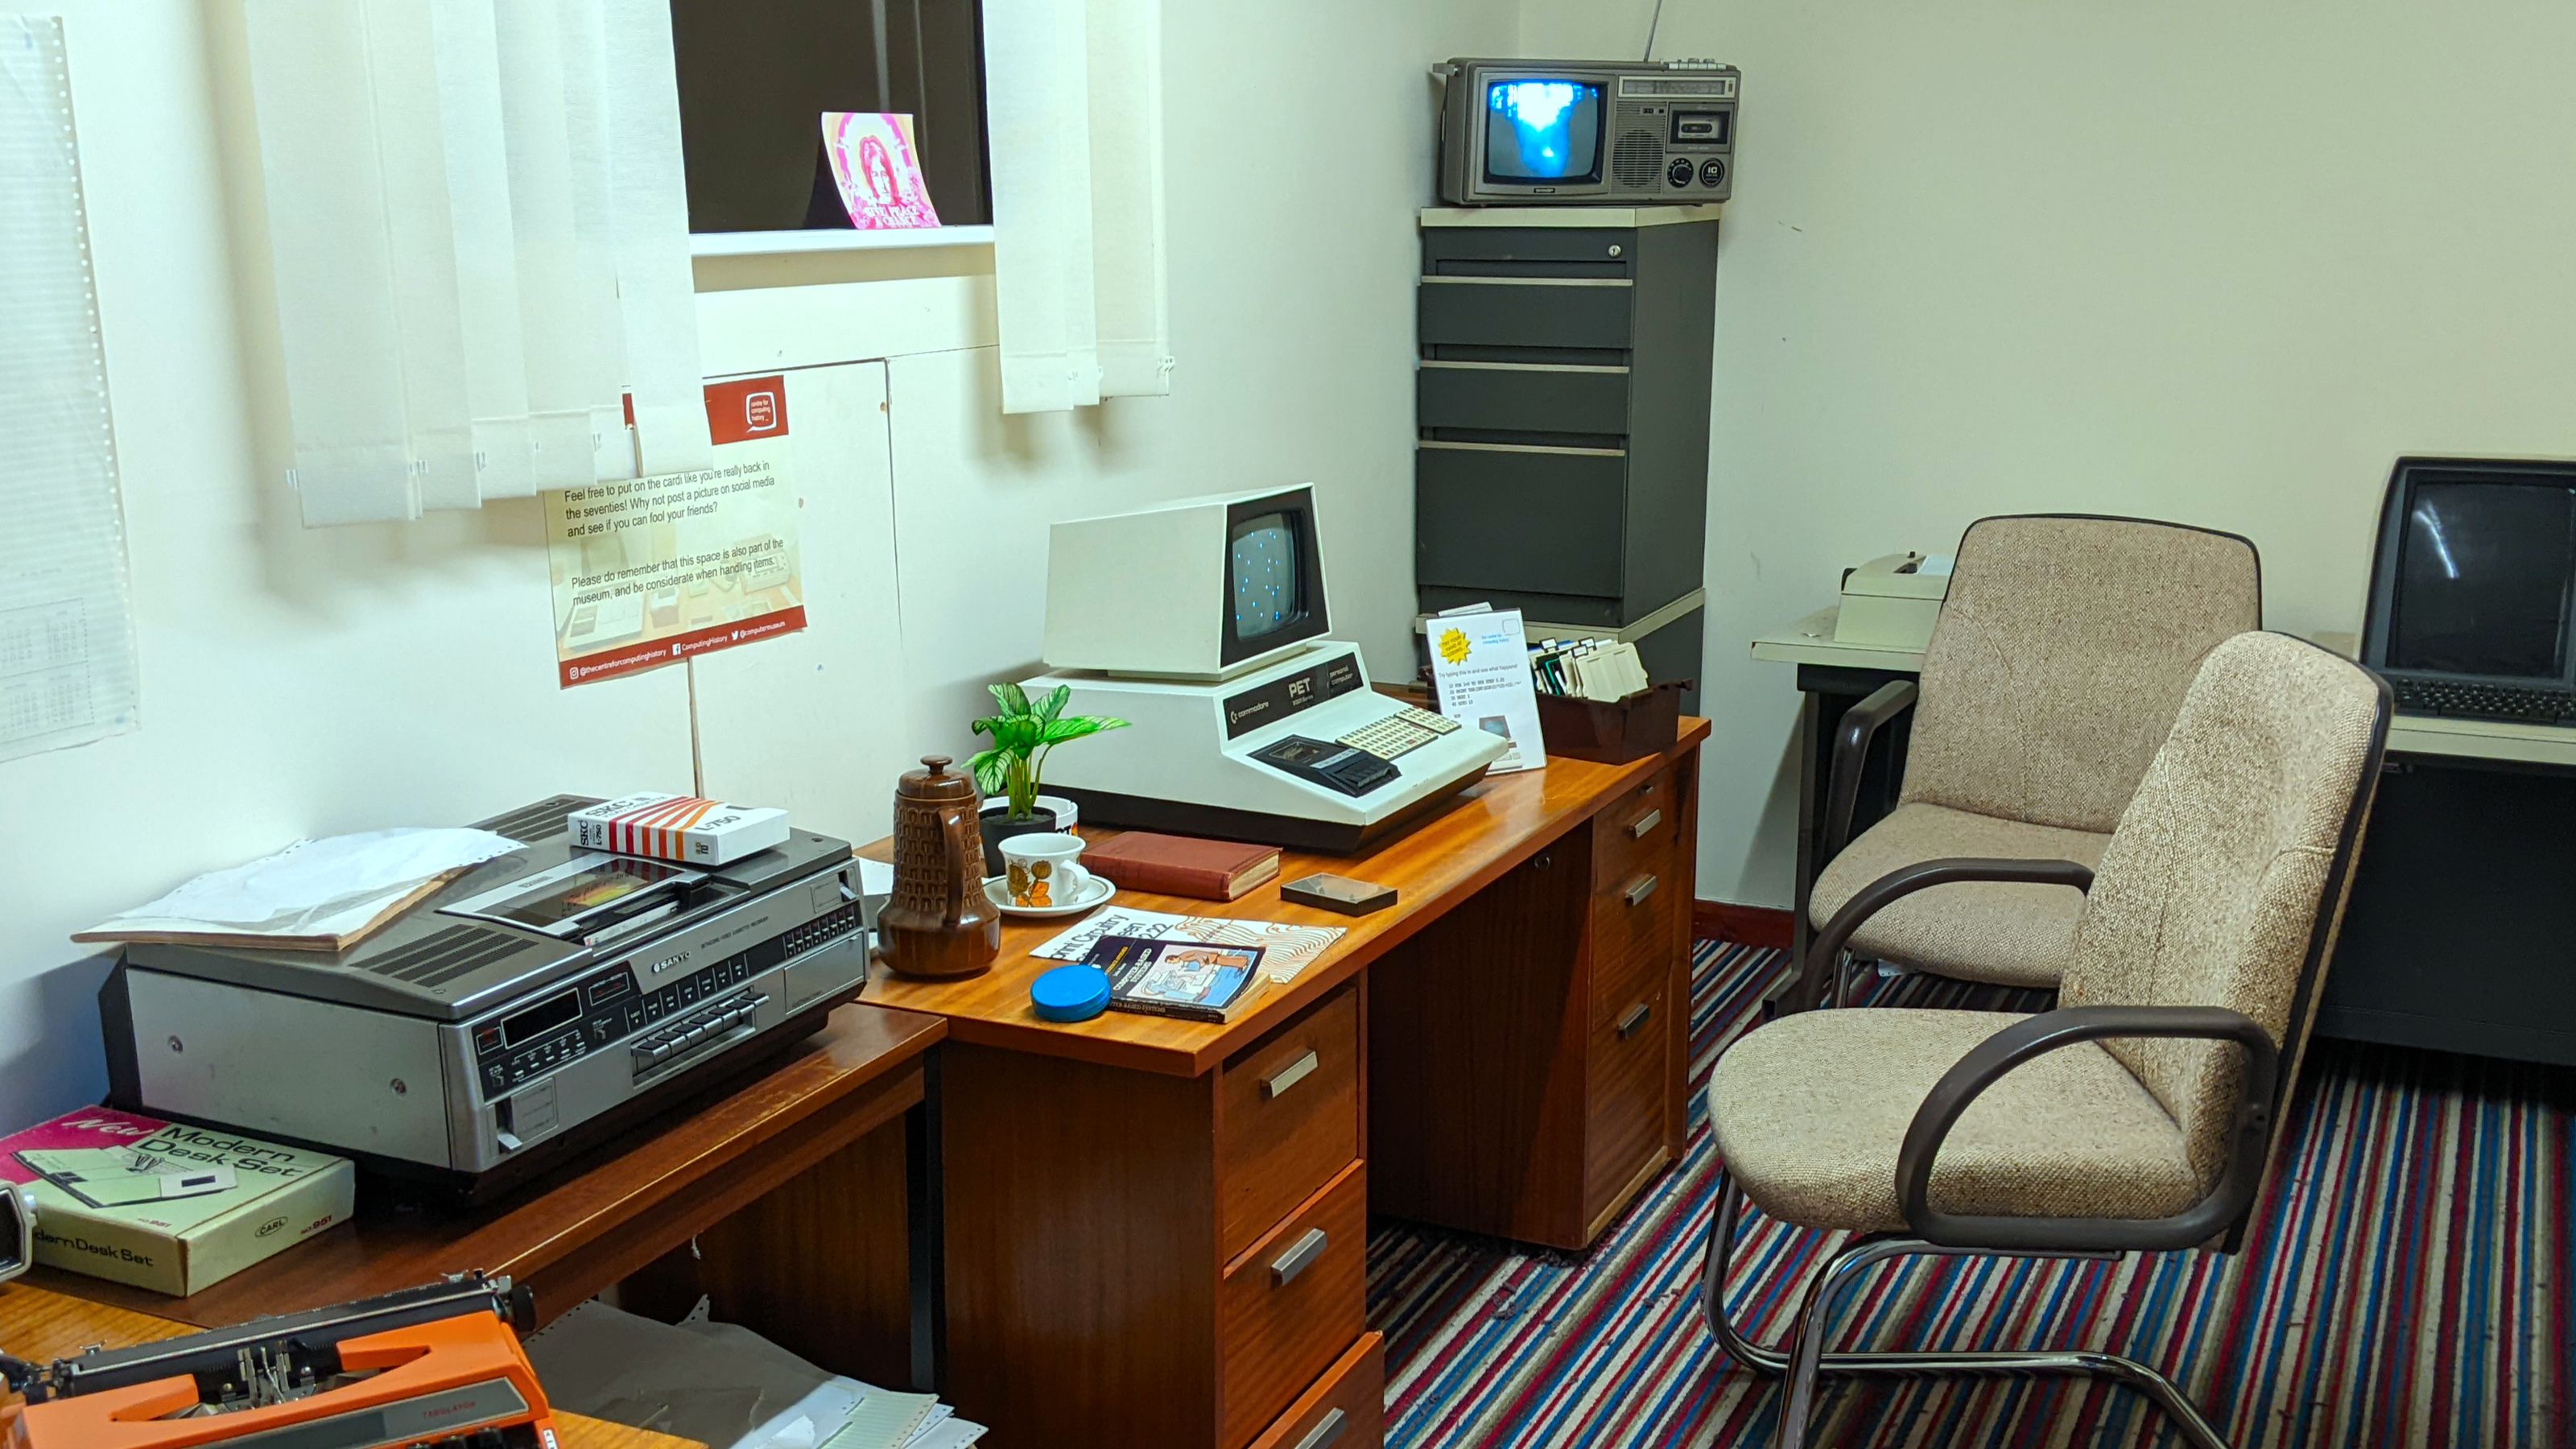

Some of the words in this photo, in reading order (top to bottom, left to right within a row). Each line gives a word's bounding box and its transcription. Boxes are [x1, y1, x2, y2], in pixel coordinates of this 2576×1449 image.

[564, 489, 585, 502] Feel
[588, 488, 604, 499] free
[606, 486, 615, 496] to
[617, 484, 632, 497] put
[634, 483, 646, 492] on
[647, 478, 661, 490] the
[663, 473, 683, 488] cardi
[684, 473, 698, 484] like
[700, 470, 722, 485] you're
[724, 464, 742, 477] really
[743, 462, 762, 474] back
[762, 460, 770, 471] in
[566, 507, 580, 520] the
[584, 501, 628, 518] seventies!
[630, 497, 650, 510] Why
[652, 495, 665, 506] not
[667, 492, 684, 505] post
[687, 491, 692, 501] a
[693, 486, 719, 502] picture
[720, 485, 730, 494] on
[731, 479, 751, 493] social
[753, 476, 774, 489] media
[568, 523, 585, 538] and
[588, 522, 604, 534] see
[605, 519, 612, 530] if
[613, 519, 630, 533] you
[632, 515, 648, 526] can
[650, 510, 664, 523] fool
[667, 510, 685, 524] your
[687, 501, 718, 517] friends?
[572, 575, 602, 589] Please
[604, 571, 615, 582] do
[617, 563, 660, 580] remember
[662, 558, 678, 571] that
[679, 555, 694, 567] this
[696, 551, 721, 566] space
[723, 548, 729, 559] is
[732, 546, 747, 558] also
[749, 542, 763, 557] part
[764, 539, 771, 551] of
[772, 539, 783, 548] the
[572, 588, 613, 606] museum,
[614, 583, 631, 597] and
[633, 582, 644, 594] be
[646, 572, 694, 591] considerate
[696, 568, 717, 580] when
[720, 560, 752, 576] handling
[753, 557, 774, 569] items.
[682, 635, 728, 651] ComputingHistory
[1329, 665, 1349, 678] personal
[1331, 673, 1353, 686] computer
[1288, 677, 1311, 698] PET
[1238, 701, 1269, 718] commodore
[585, 800, 634, 816] SKC
[580, 819, 588, 846] SKC
[694, 815, 741, 831] L-750
[660, 951, 691, 970] SANYO
[161, 1127, 296, 1162] Modern
[138, 1138, 231, 1166] Desk
[233, 1158, 303, 1177] Set
[260, 1219, 284, 1235] CARL
[76, 1237, 119, 1258] Desk
[121, 1249, 154, 1267] Set
